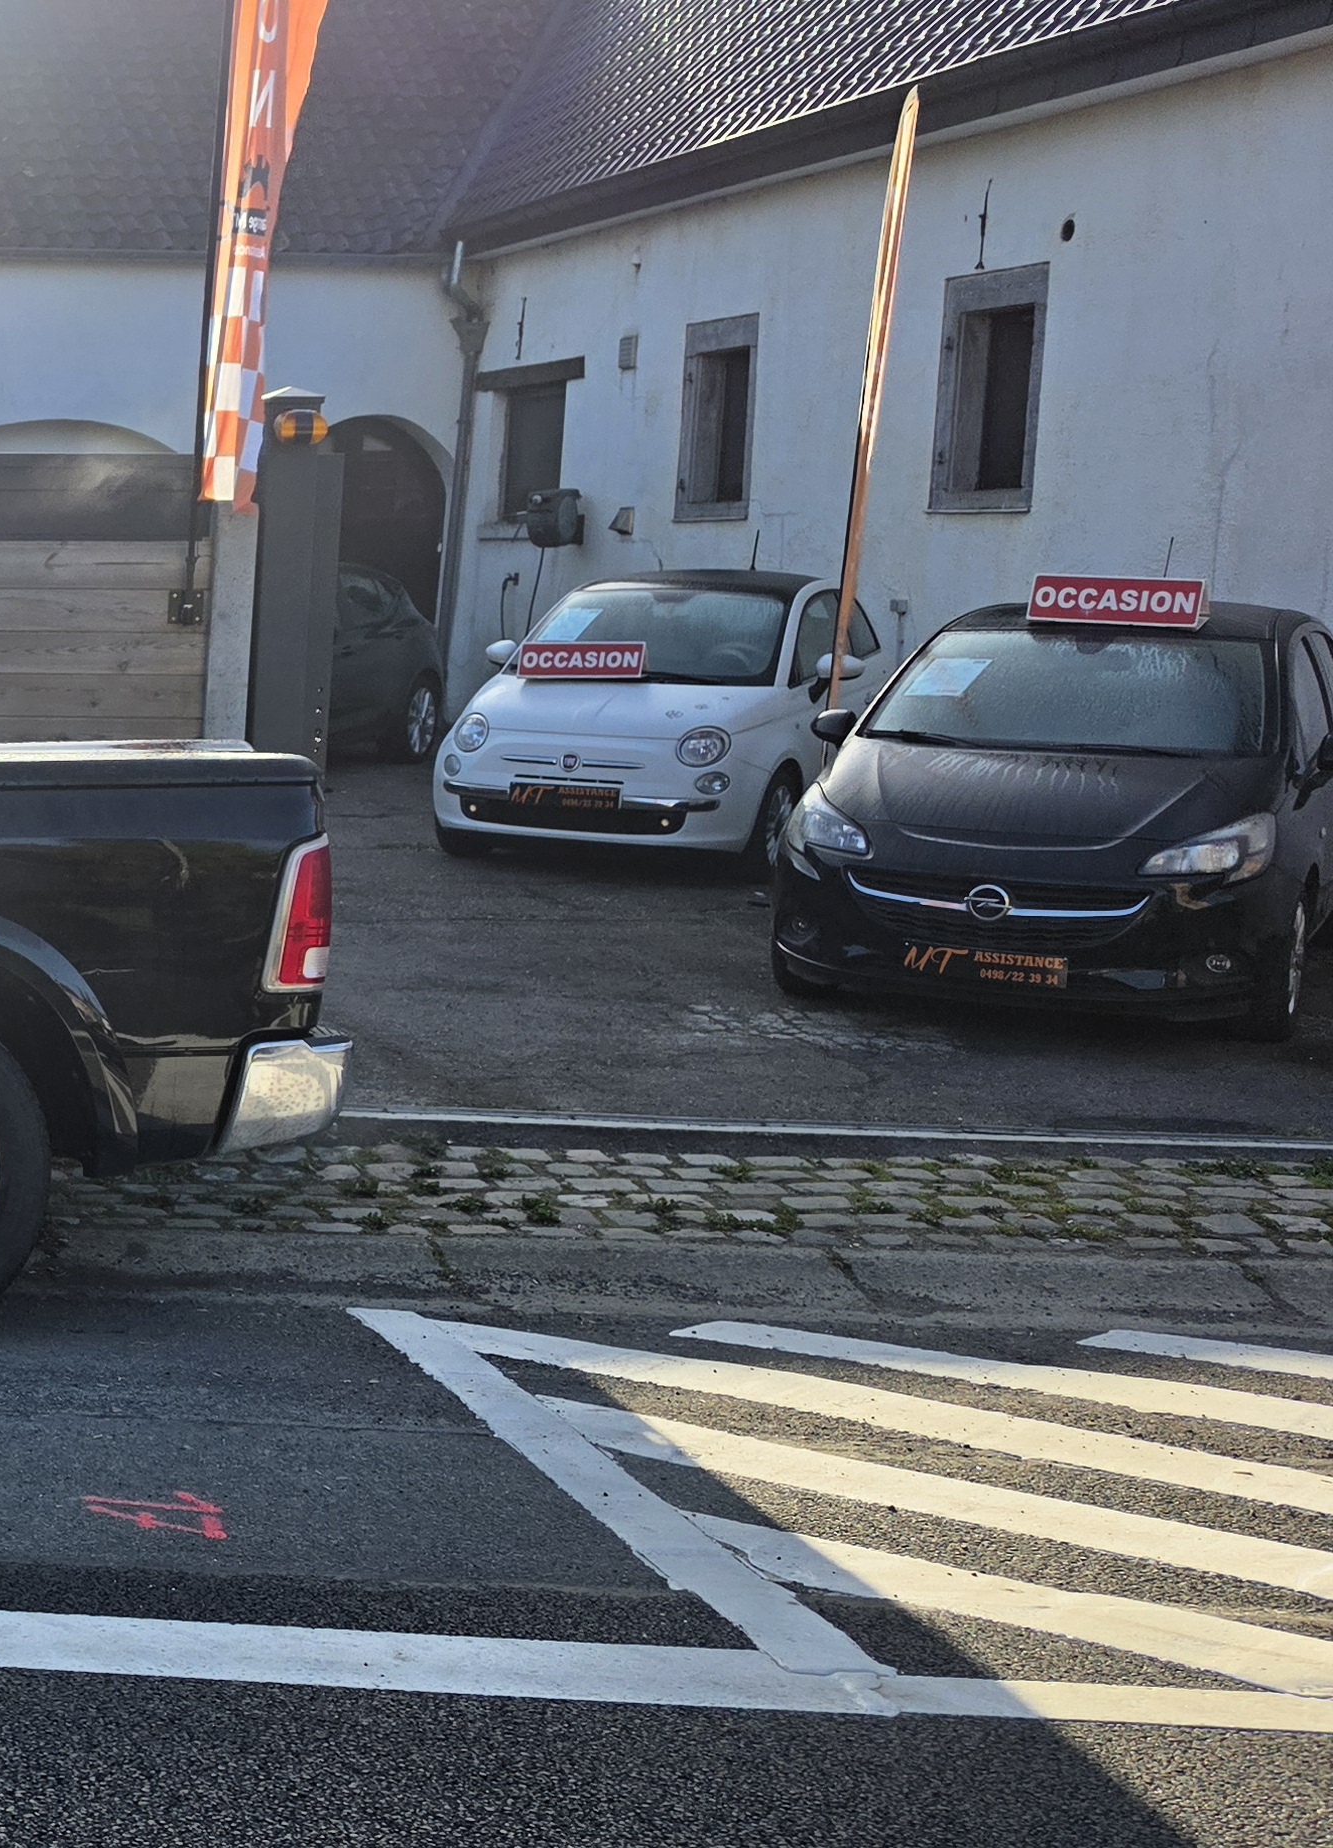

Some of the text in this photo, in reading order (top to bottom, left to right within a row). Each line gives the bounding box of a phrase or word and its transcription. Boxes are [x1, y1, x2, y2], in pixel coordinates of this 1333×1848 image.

[1035, 586, 1196, 614] OCCASION
[522, 651, 639, 668] OCCASION
[511, 785, 555, 804] MT
[558, 786, 617, 797] ASSISTANCE
[903, 945, 969, 975] MT
[973, 950, 1064, 970] ASSISTANCE
[1028, 973, 1042, 984] 39
[1045, 974, 1059, 986] 34
